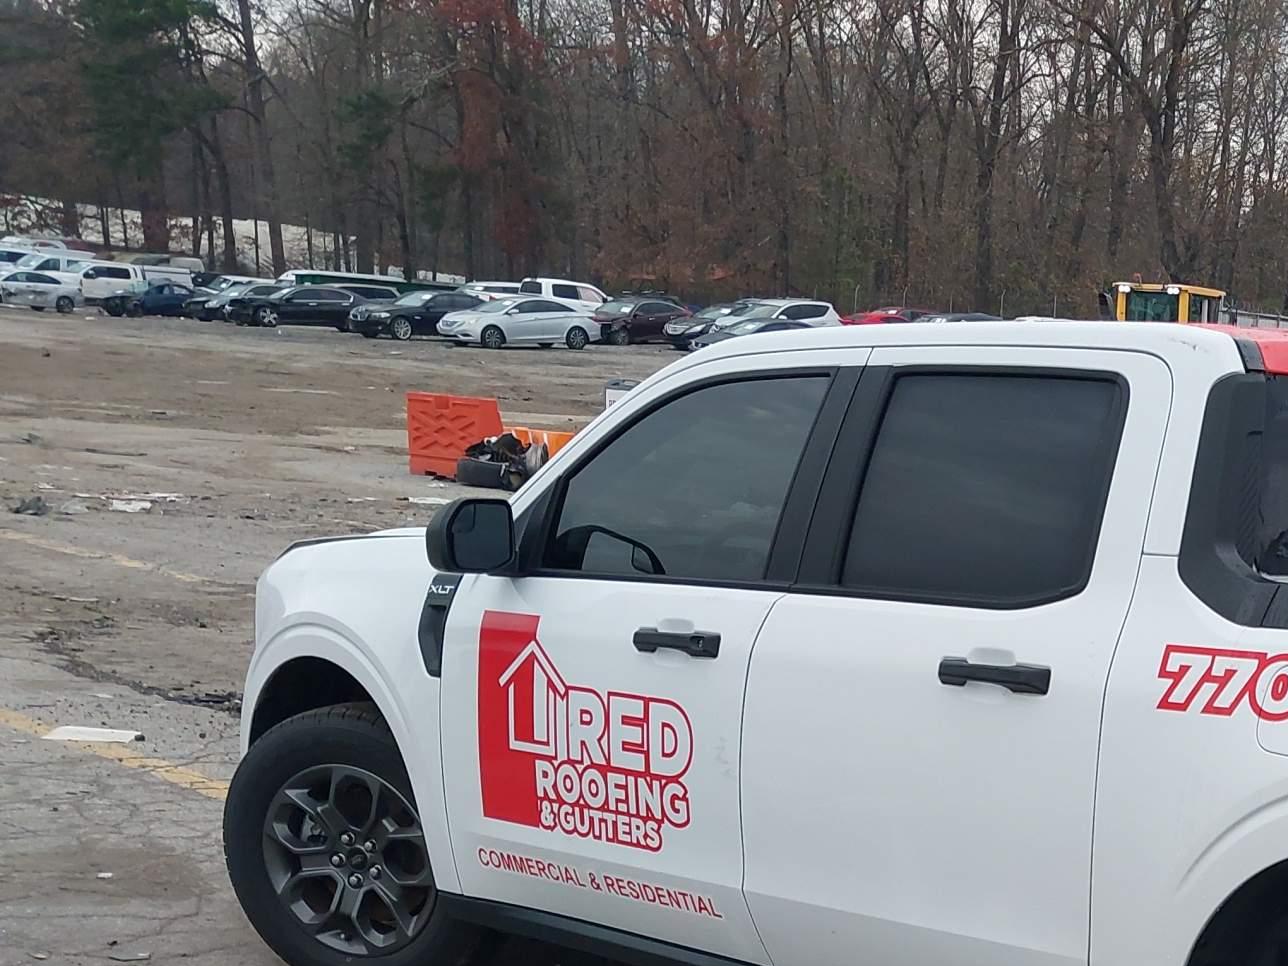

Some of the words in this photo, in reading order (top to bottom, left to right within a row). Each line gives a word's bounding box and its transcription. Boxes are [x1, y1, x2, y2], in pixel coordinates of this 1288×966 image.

[429, 584, 455, 595] XLT
[563, 684, 694, 779] RED
[534, 759, 691, 828] ROOFING
[539, 801, 556, 832] &
[553, 804, 662, 852] GUTTERS
[477, 847, 587, 889] COMMERCIAL
[588, 871, 602, 892] &
[603, 874, 724, 919] RESIDENTIAL
